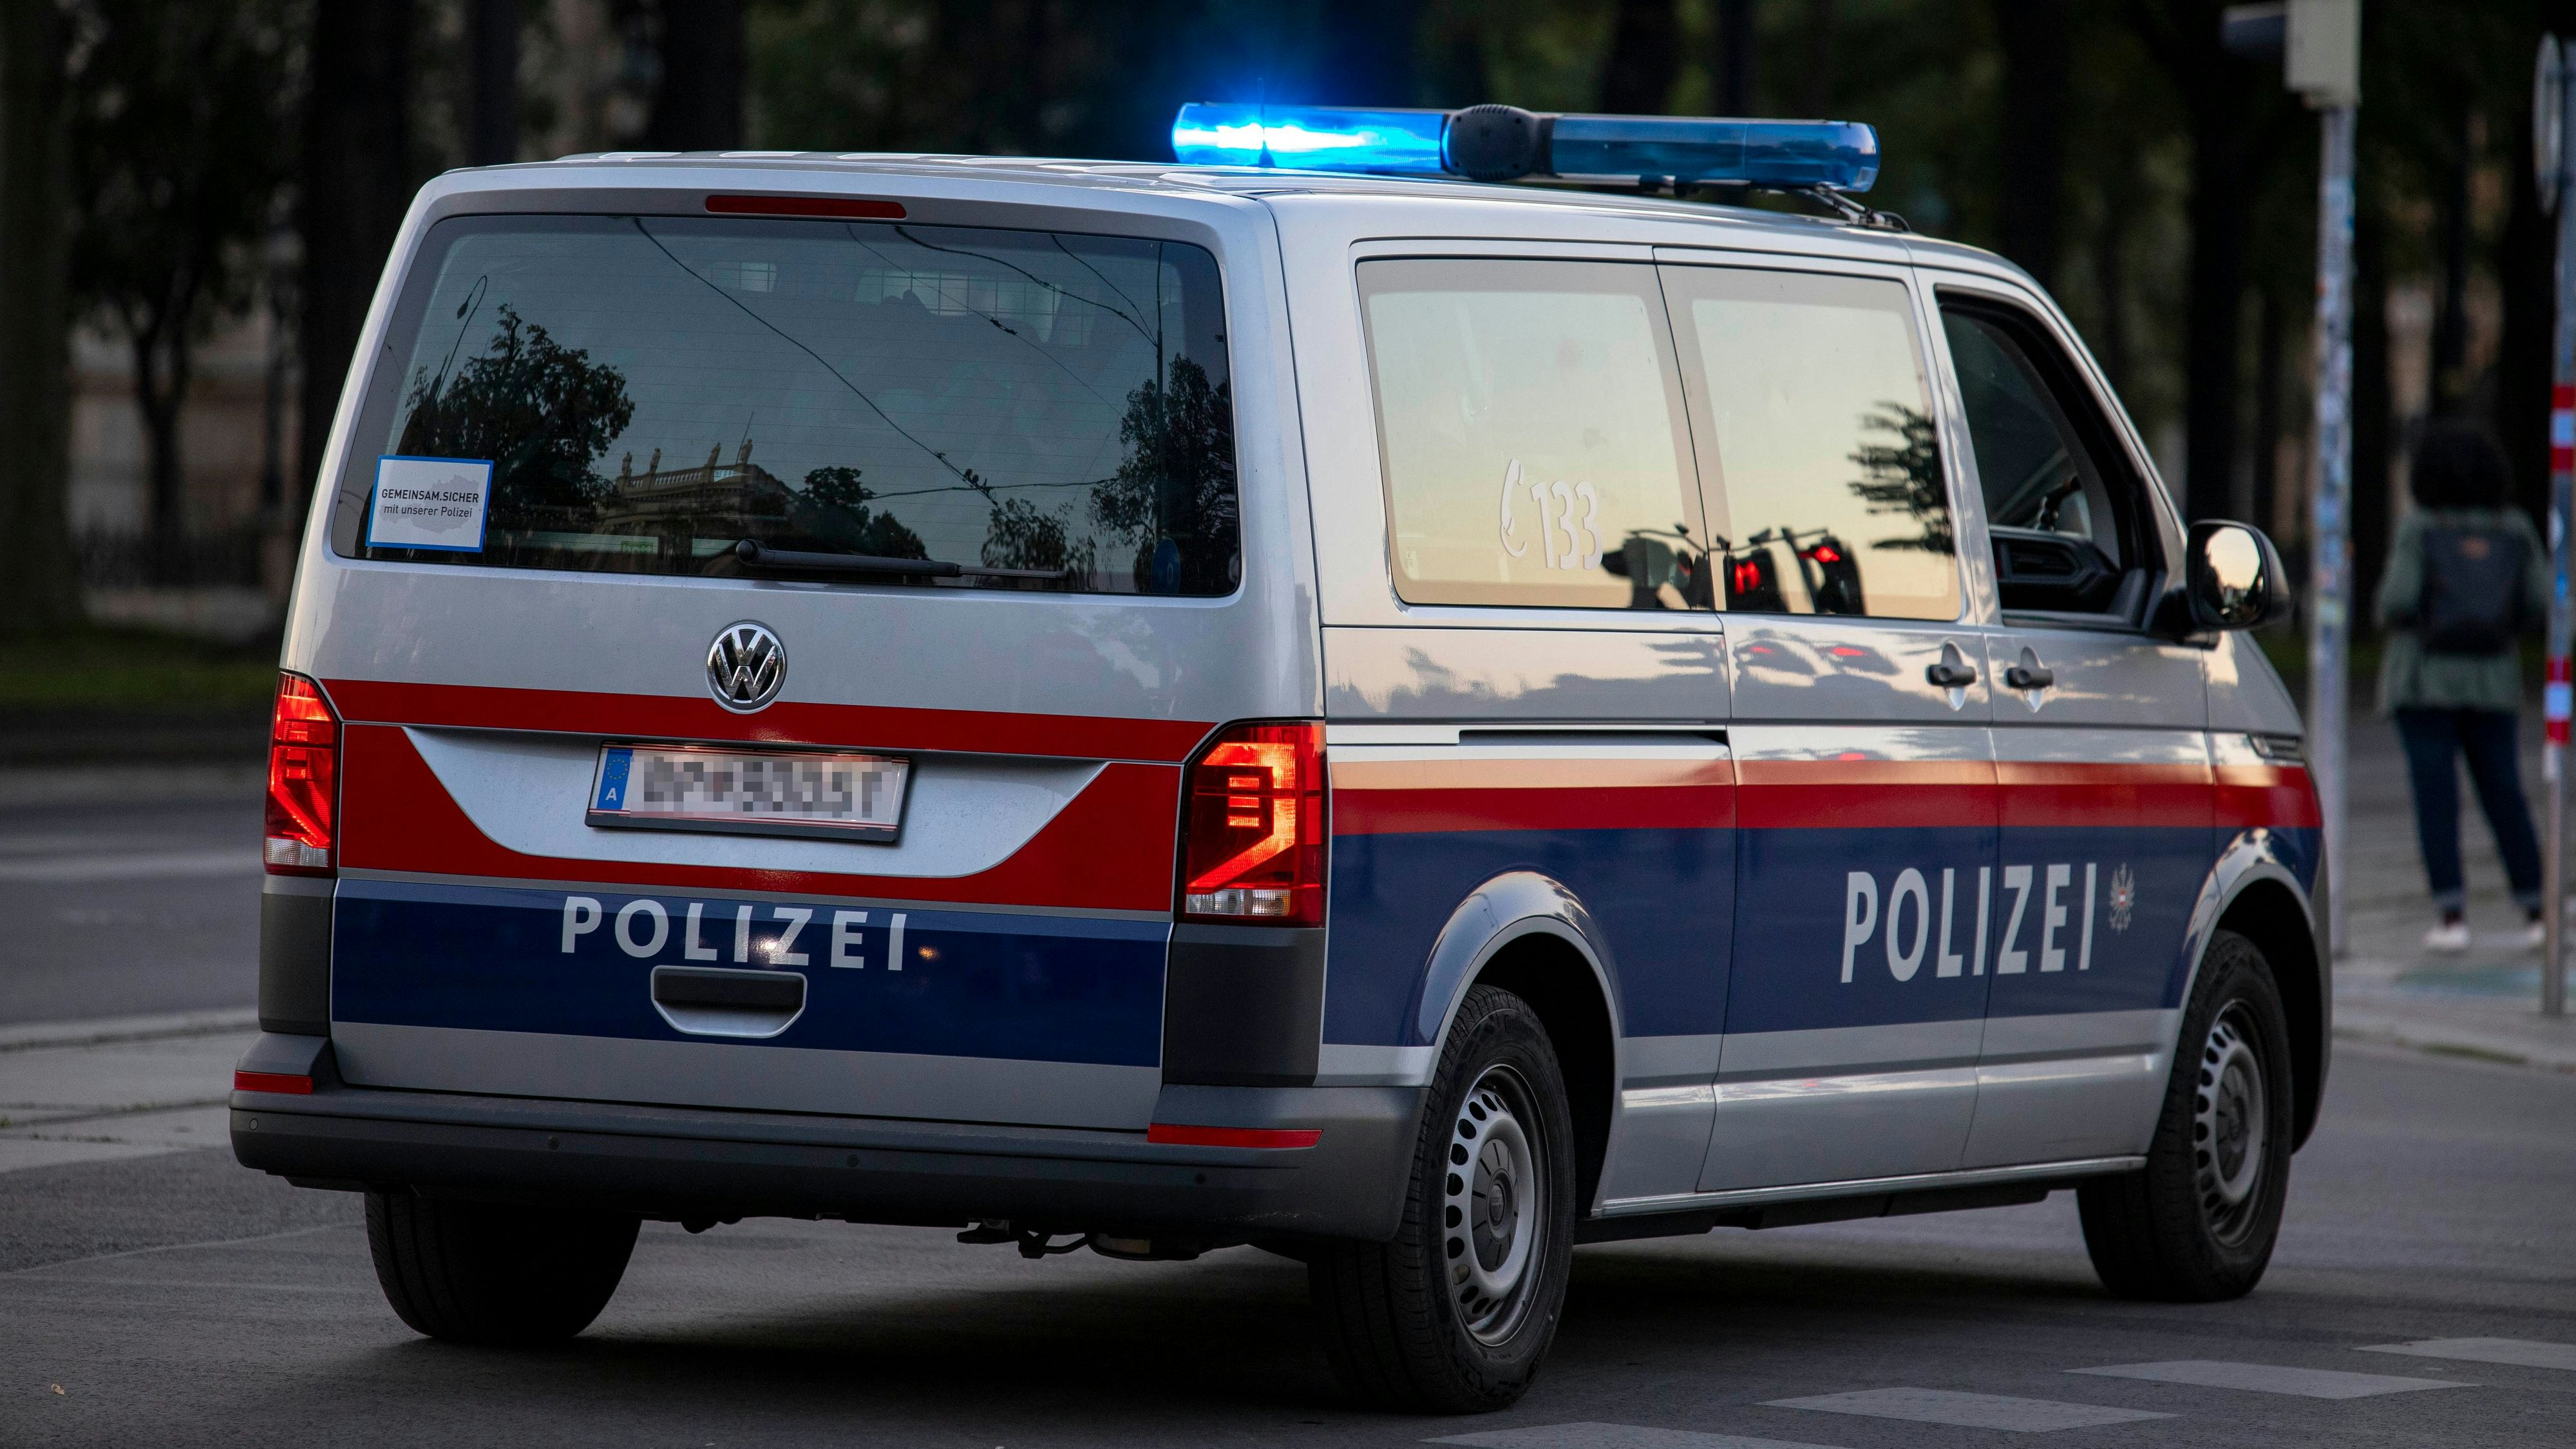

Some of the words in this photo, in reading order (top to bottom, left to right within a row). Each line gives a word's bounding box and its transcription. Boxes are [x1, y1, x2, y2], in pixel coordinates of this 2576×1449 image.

[381, 489, 479, 503] GEMEINSAM.SICHER
[384, 504, 399, 514] mit
[401, 507, 438, 516] unserer
[440, 507, 472, 518] Polizei
[1530, 480, 1604, 569] 133
[708, 623, 782, 706] VW
[605, 787, 617, 801] A
[561, 896, 907, 971] POLIZEI
[1841, 862, 2097, 983] POLIZEI
